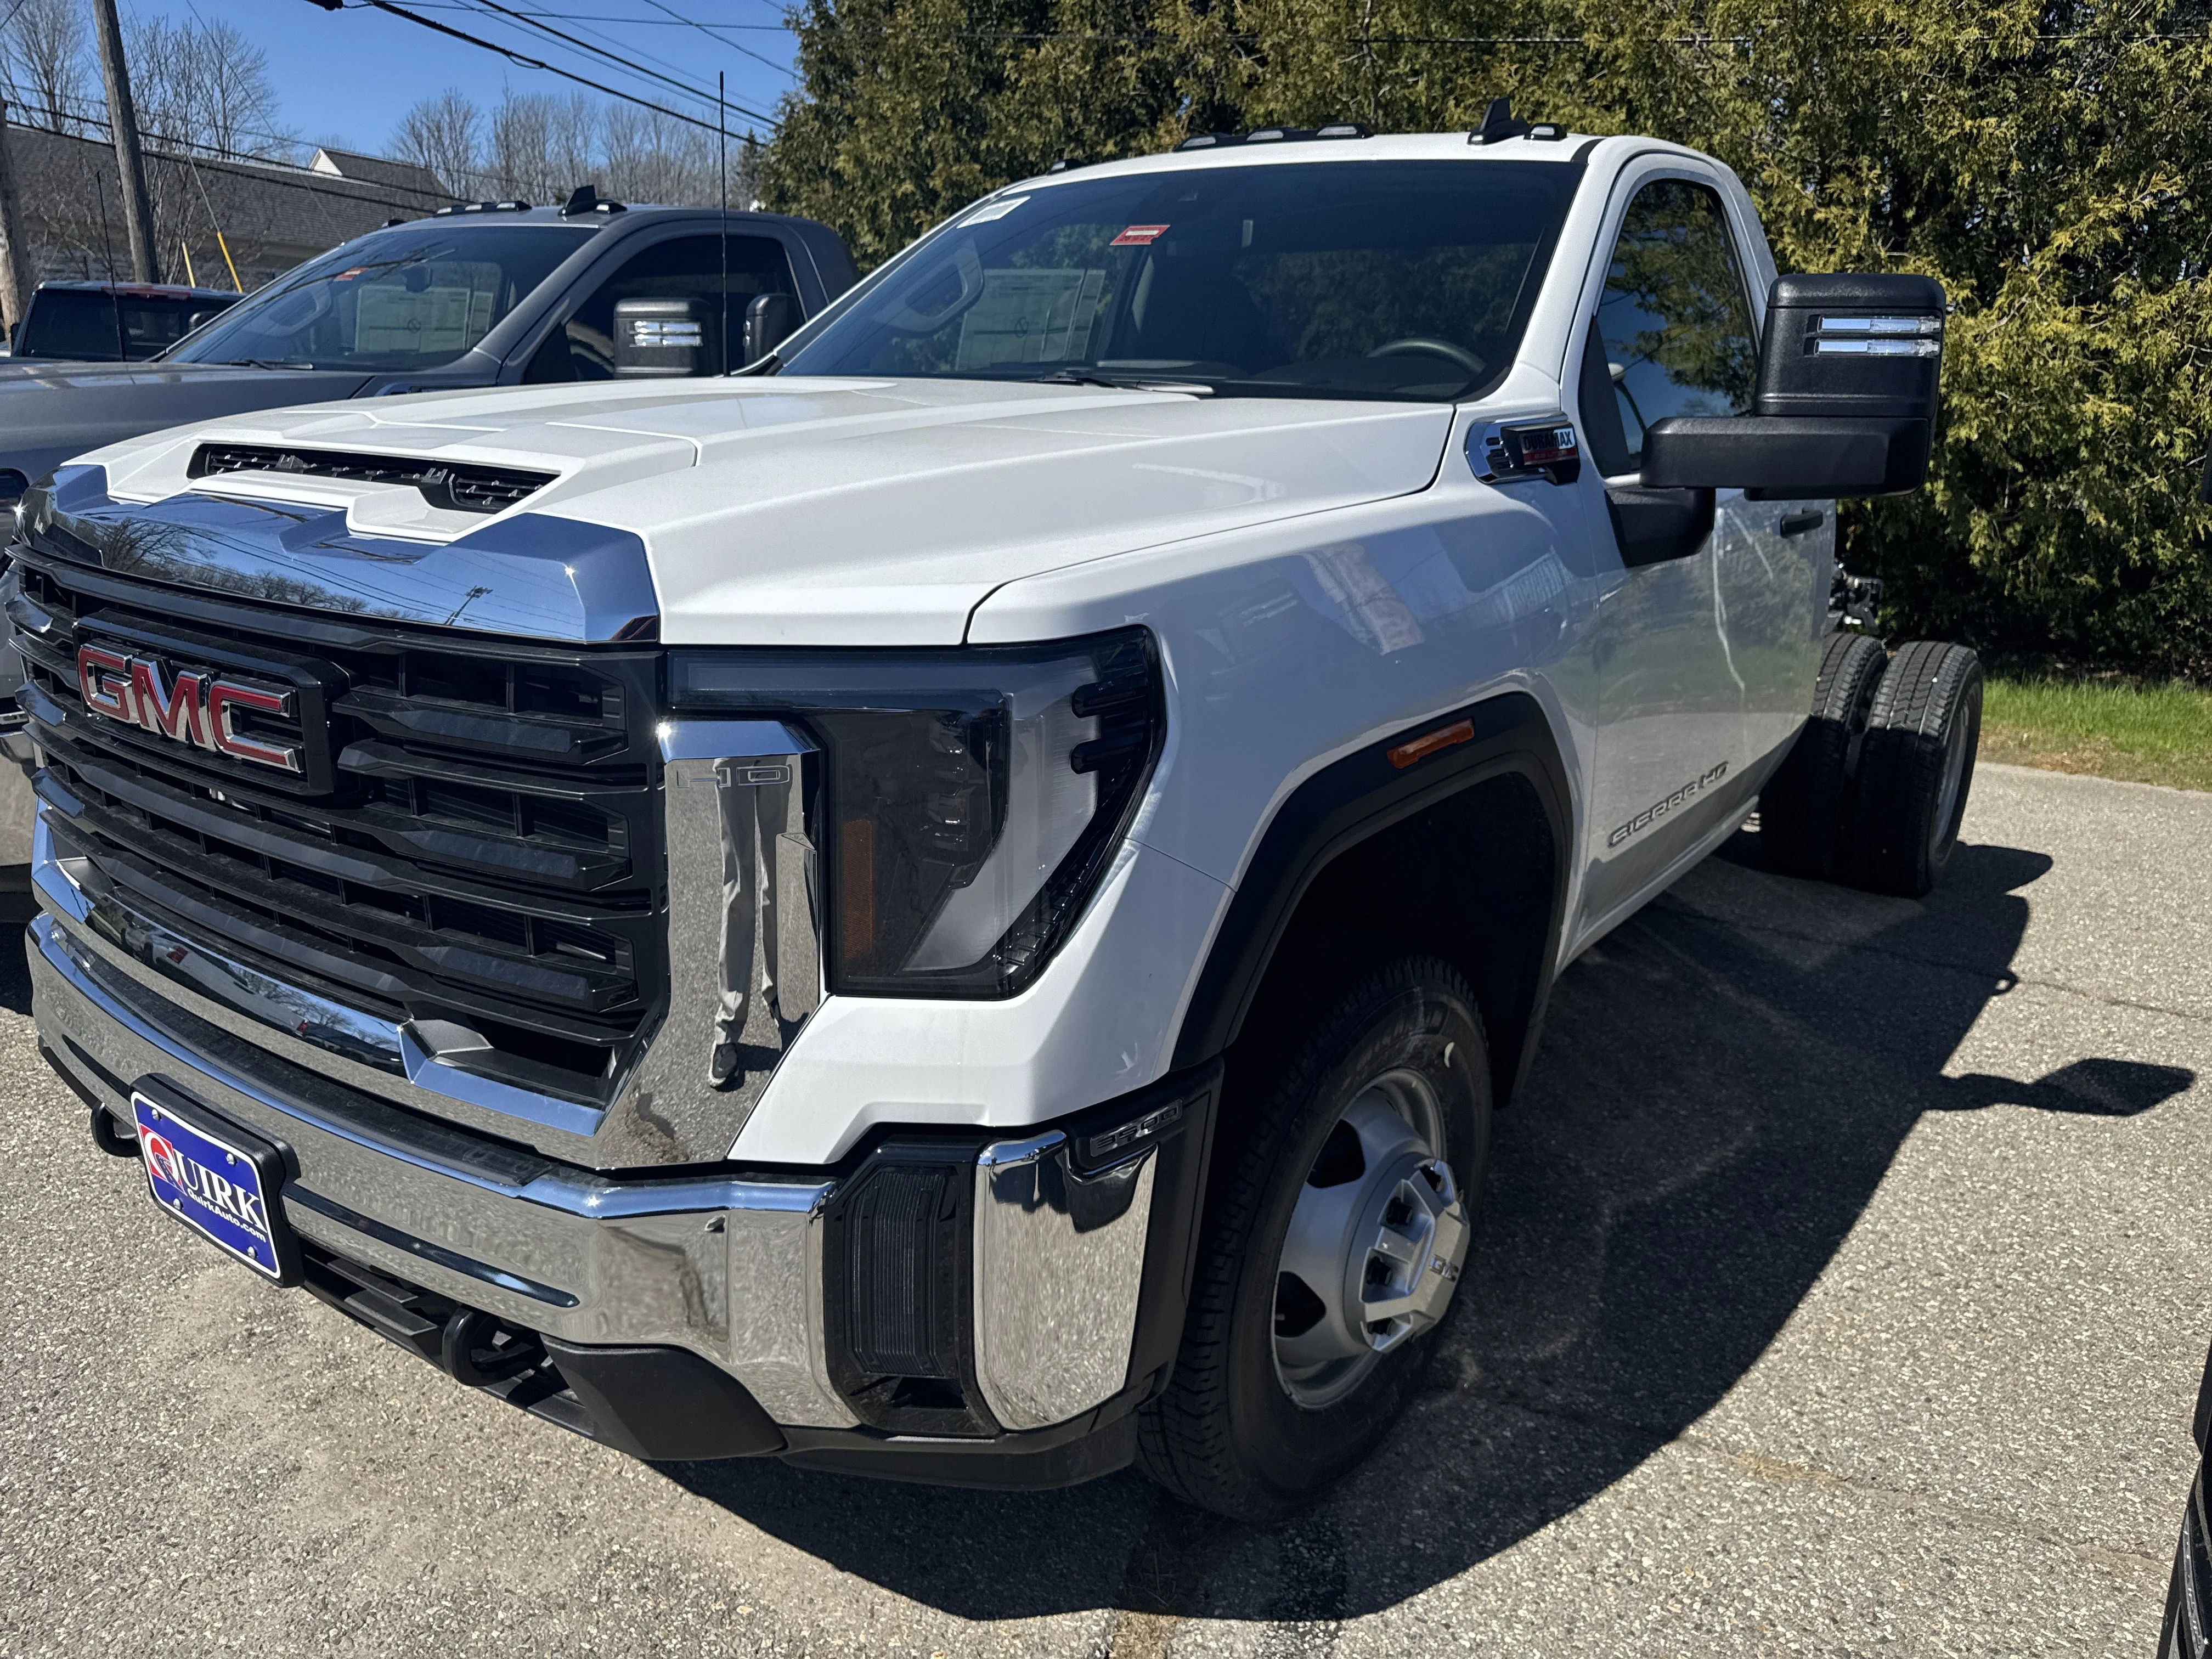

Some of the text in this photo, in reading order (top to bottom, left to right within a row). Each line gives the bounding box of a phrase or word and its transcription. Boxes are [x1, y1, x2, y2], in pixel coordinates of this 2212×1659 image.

[78, 643, 303, 773] GMC
[676, 765, 790, 788] HD
[1607, 760, 1729, 848] SIERRA HD
[1096, 1106, 1178, 1150] 3500
[143, 1130, 268, 1234] QUIRK
[187, 1187, 267, 1243] QuirkAuto.com
